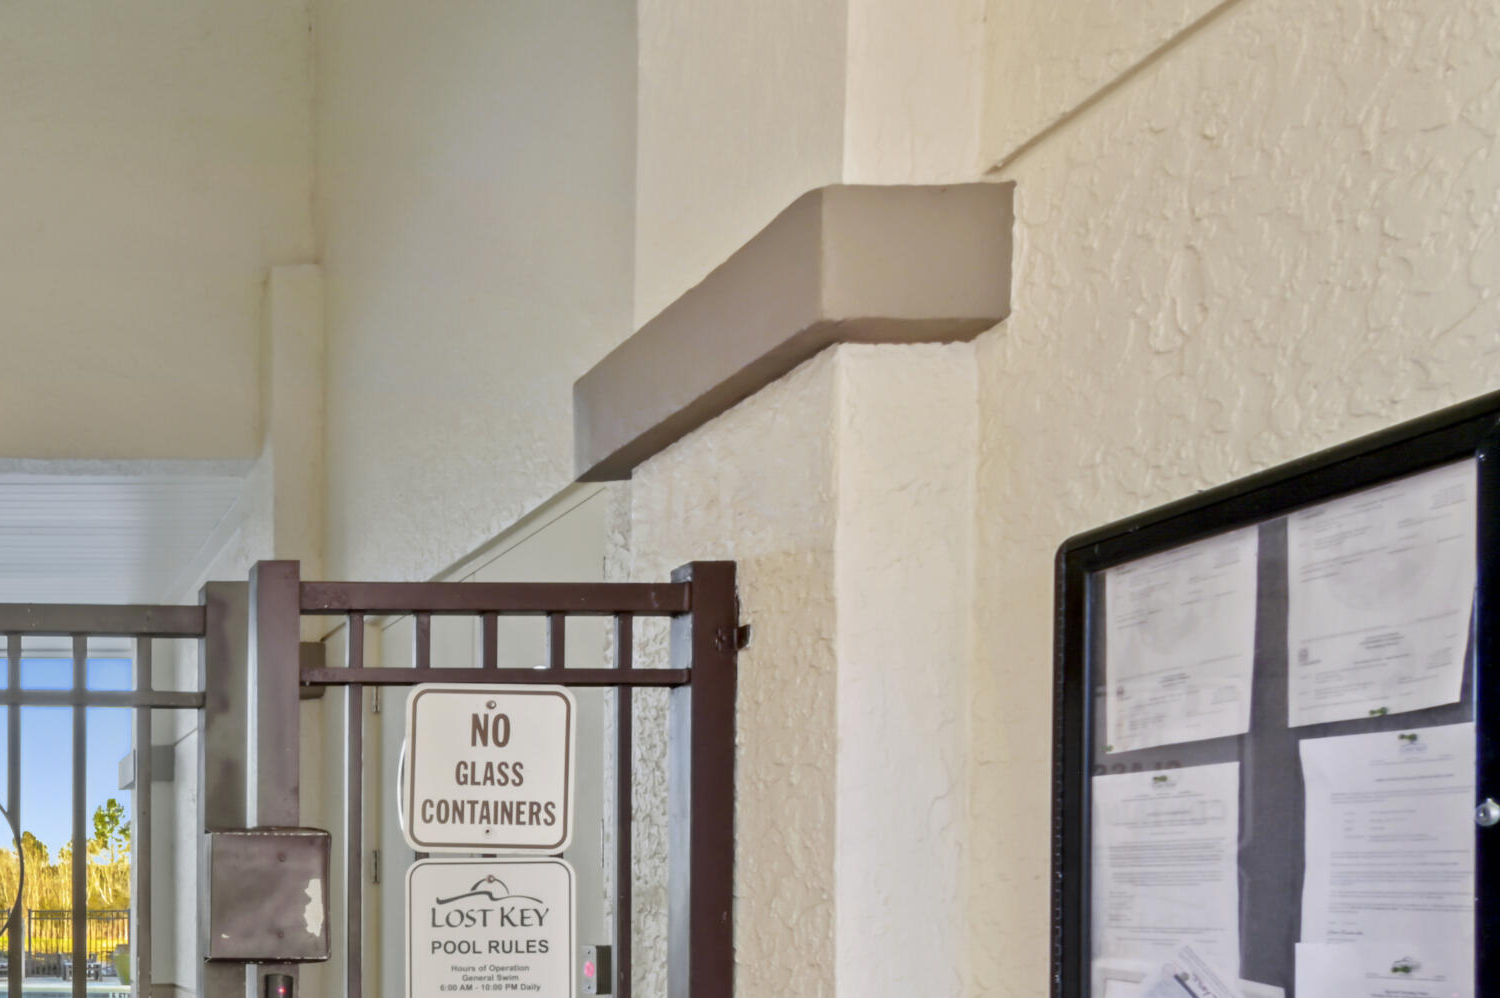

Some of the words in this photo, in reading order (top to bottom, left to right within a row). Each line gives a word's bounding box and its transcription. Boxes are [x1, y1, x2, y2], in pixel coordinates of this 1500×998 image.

[470, 713, 511, 748] NO
[454, 761, 525, 787] GLASS
[421, 798, 556, 826] CONTAINERS
[431, 907, 495, 928] LOST
[500, 906, 549, 927] KEY
[431, 940, 482, 955] POOL
[488, 939, 549, 954] RULES
[462, 974, 494, 982] General
[489, 964, 530, 973] Operation
[520, 984, 541, 992] Daily
